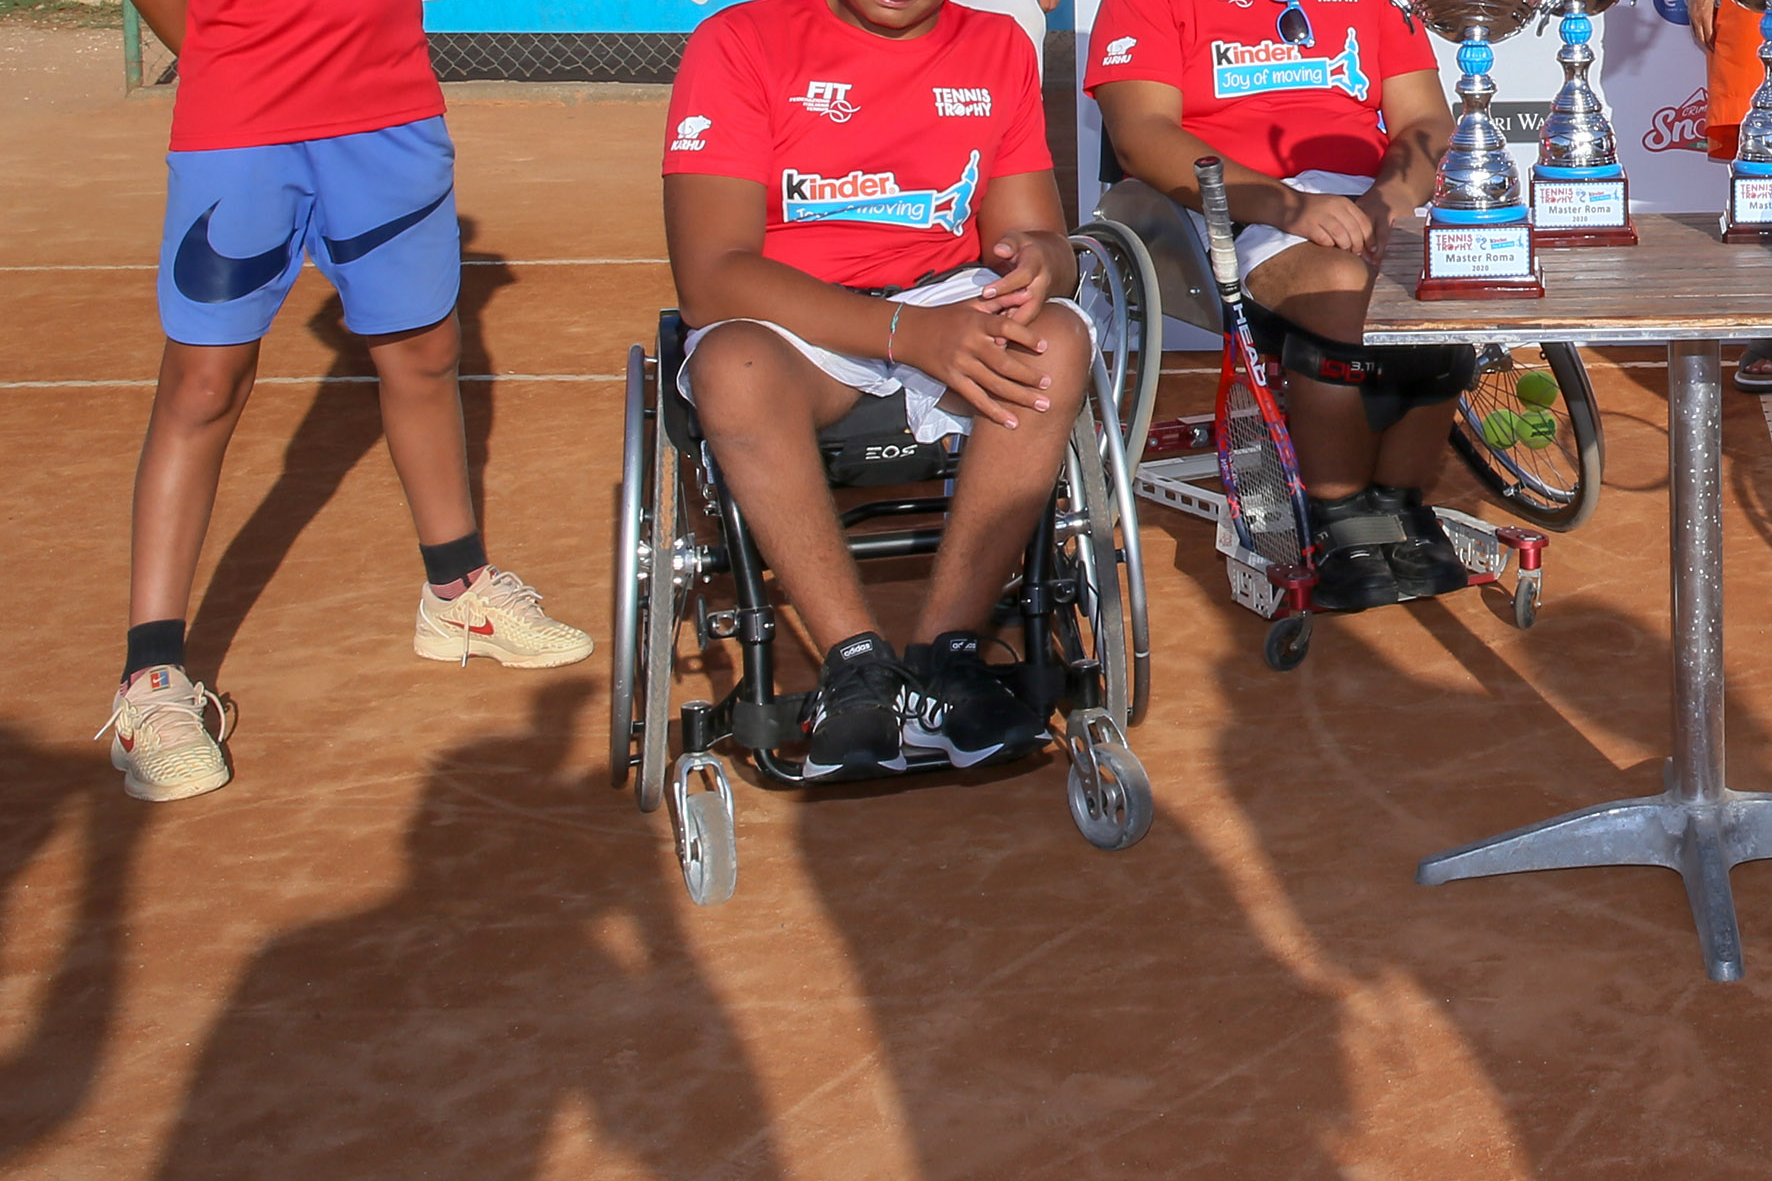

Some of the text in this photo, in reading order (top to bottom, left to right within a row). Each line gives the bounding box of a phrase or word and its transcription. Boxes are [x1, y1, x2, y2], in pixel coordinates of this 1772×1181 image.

[1215, 44, 1294, 66] Kinder
[1222, 66, 1322, 89] Joy of moving
[807, 81, 852, 101] FIT
[932, 88, 991, 103] TENNIS
[934, 102, 991, 117] TROPHY
[786, 173, 891, 200] Kinder
[1549, 205, 1611, 214] Master Roma
[1436, 234, 1473, 243] TENNIS
[1437, 243, 1472, 251] TROPHY
[1446, 253, 1514, 263] Master Roma
[1233, 303, 1267, 386] HEAD
[843, 642, 871, 658] adidas
